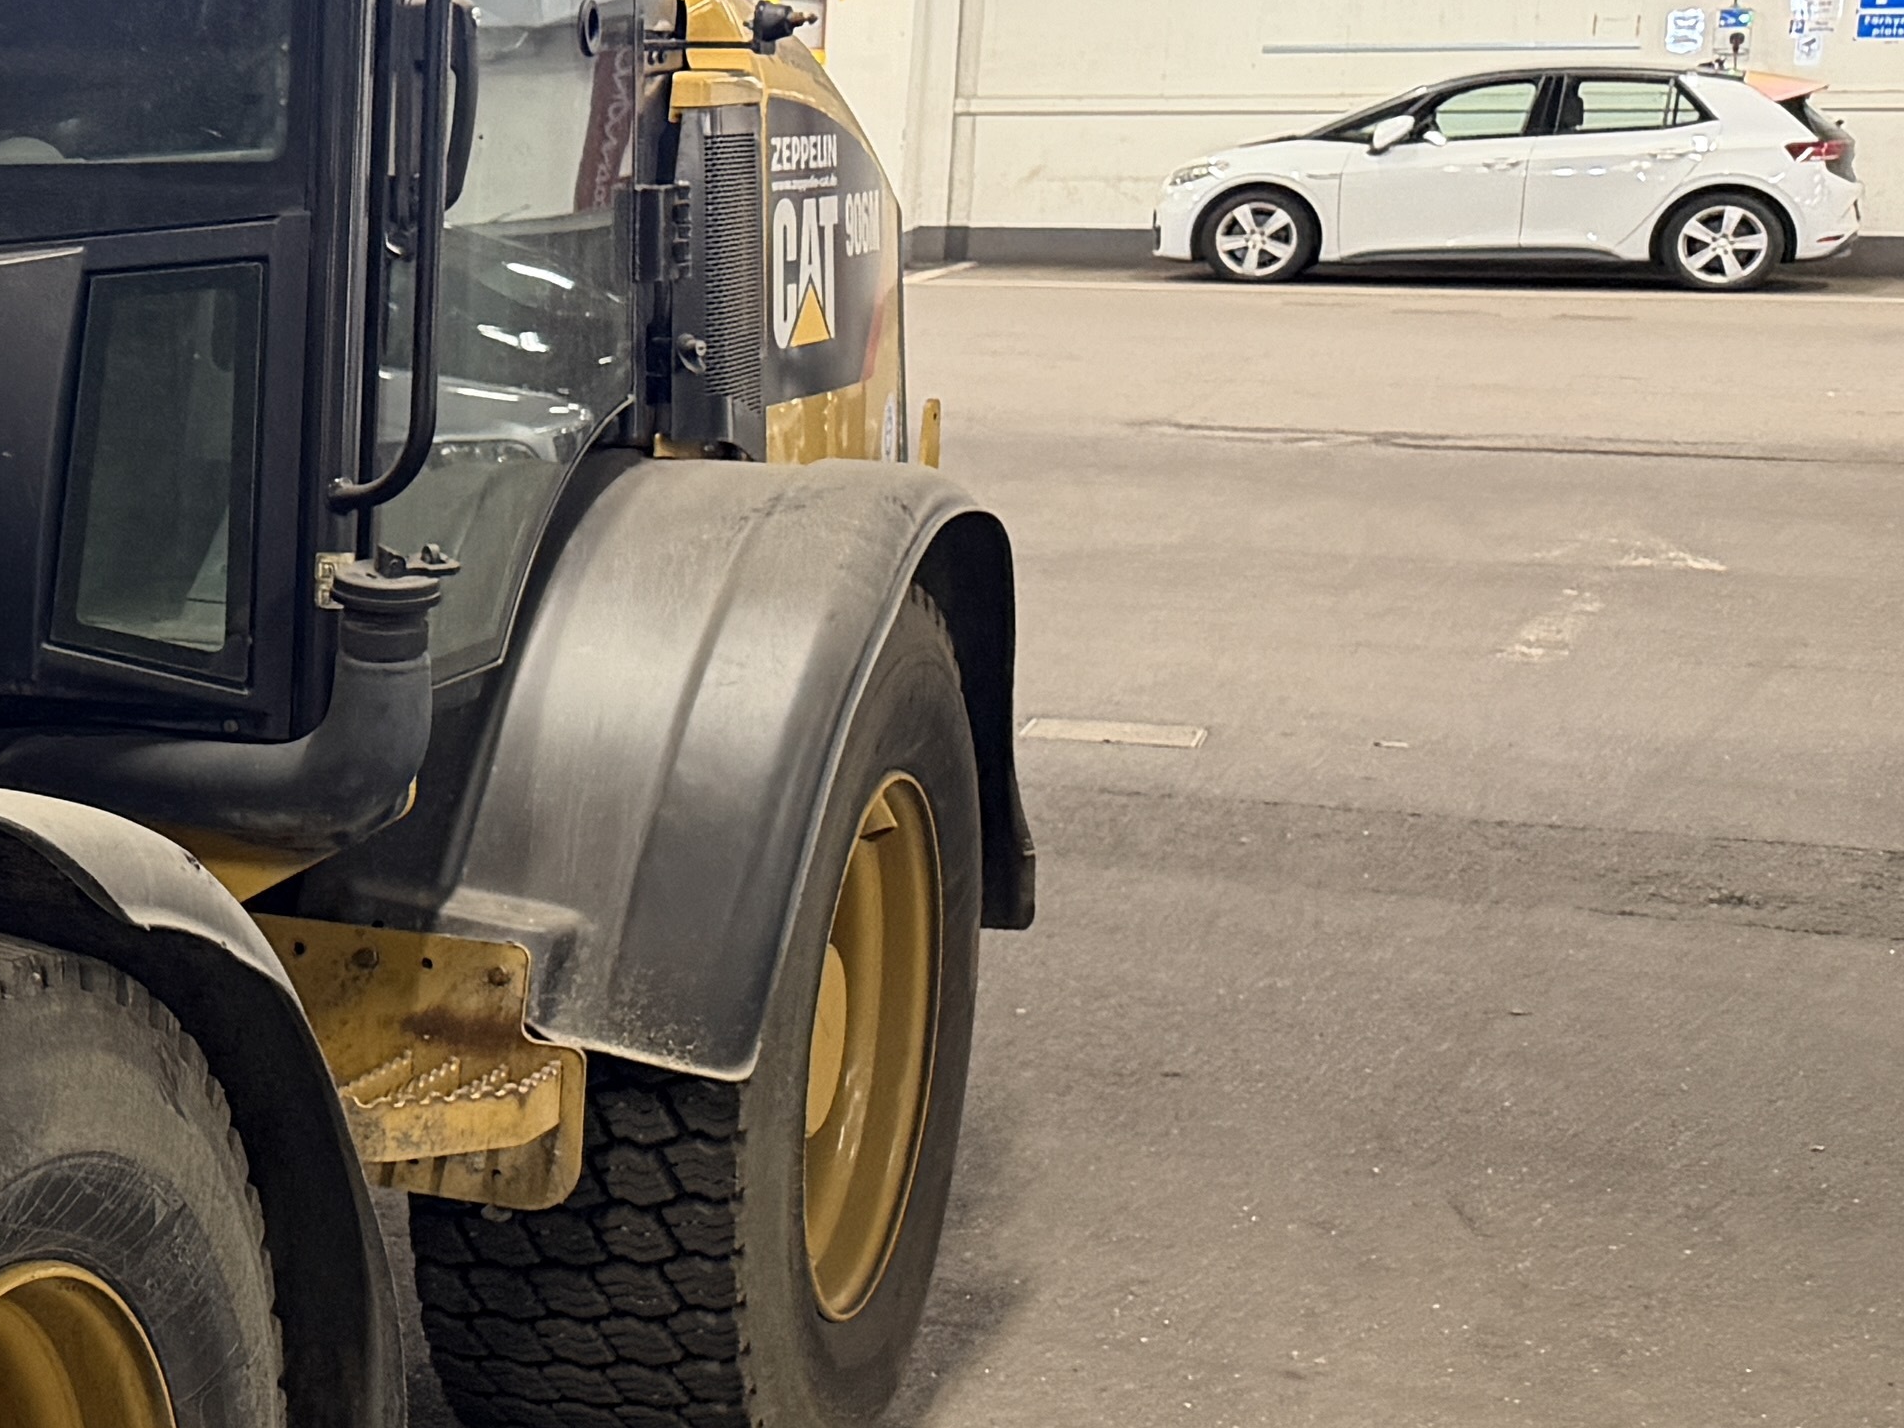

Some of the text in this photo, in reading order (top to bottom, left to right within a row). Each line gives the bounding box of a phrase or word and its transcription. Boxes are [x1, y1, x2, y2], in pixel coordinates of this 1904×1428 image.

[771, 134, 837, 172] ZEPPELIN
[845, 189, 880, 257] 906M
[773, 195, 838, 349] CAT
